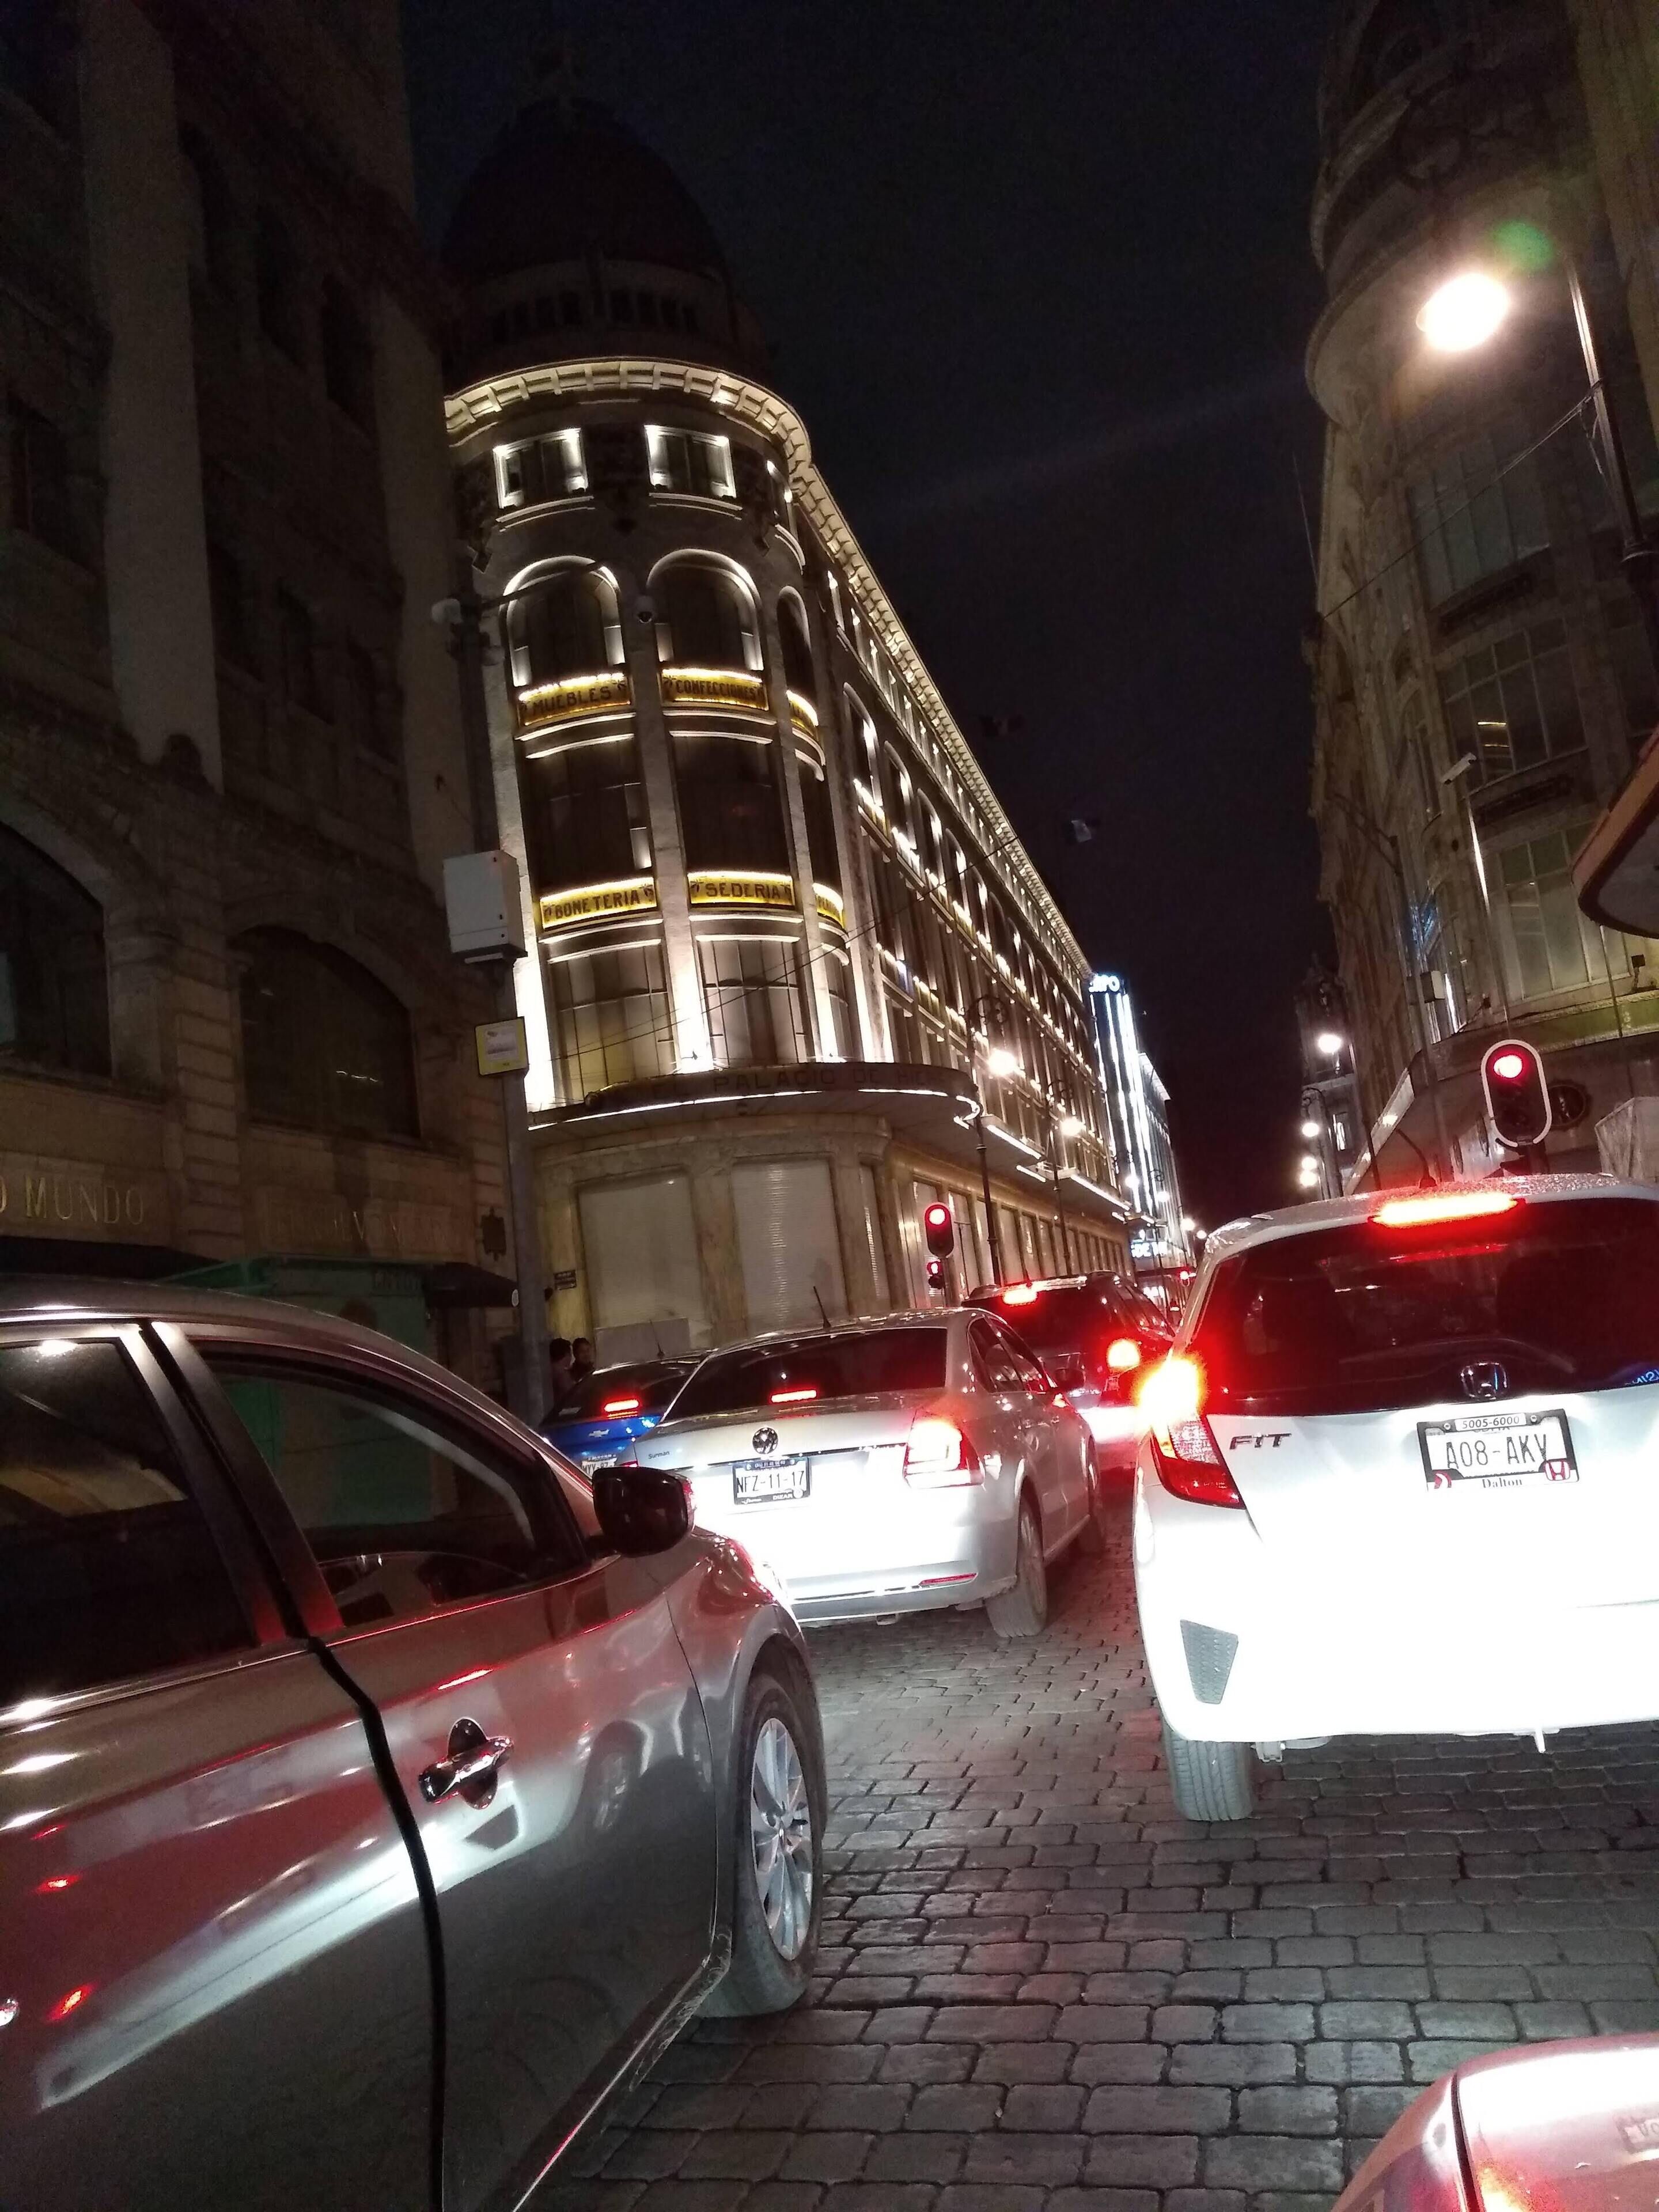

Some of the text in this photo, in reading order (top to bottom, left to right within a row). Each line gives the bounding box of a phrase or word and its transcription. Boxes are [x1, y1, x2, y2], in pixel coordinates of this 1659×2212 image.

[533, 686, 611, 715] MUEBLES
[706, 882, 780, 899] SEDERIA
[555, 890, 640, 919] BONETERIA
[713, 1068, 834, 1093] PALACIO
[853, 1067, 878, 1084] DE
[25, 1175, 143, 1225] MUNDO
[1461, 1416, 1520, 1430] 5005-6000
[1229, 1433, 1292, 1450] FIT
[1445, 1434, 1547, 1470] A08-AKV
[648, 1449, 670, 1460] Surman
[737, 1470, 805, 1494] NFZ-11-17
[1482, 1478, 1523, 1489] Dalton
